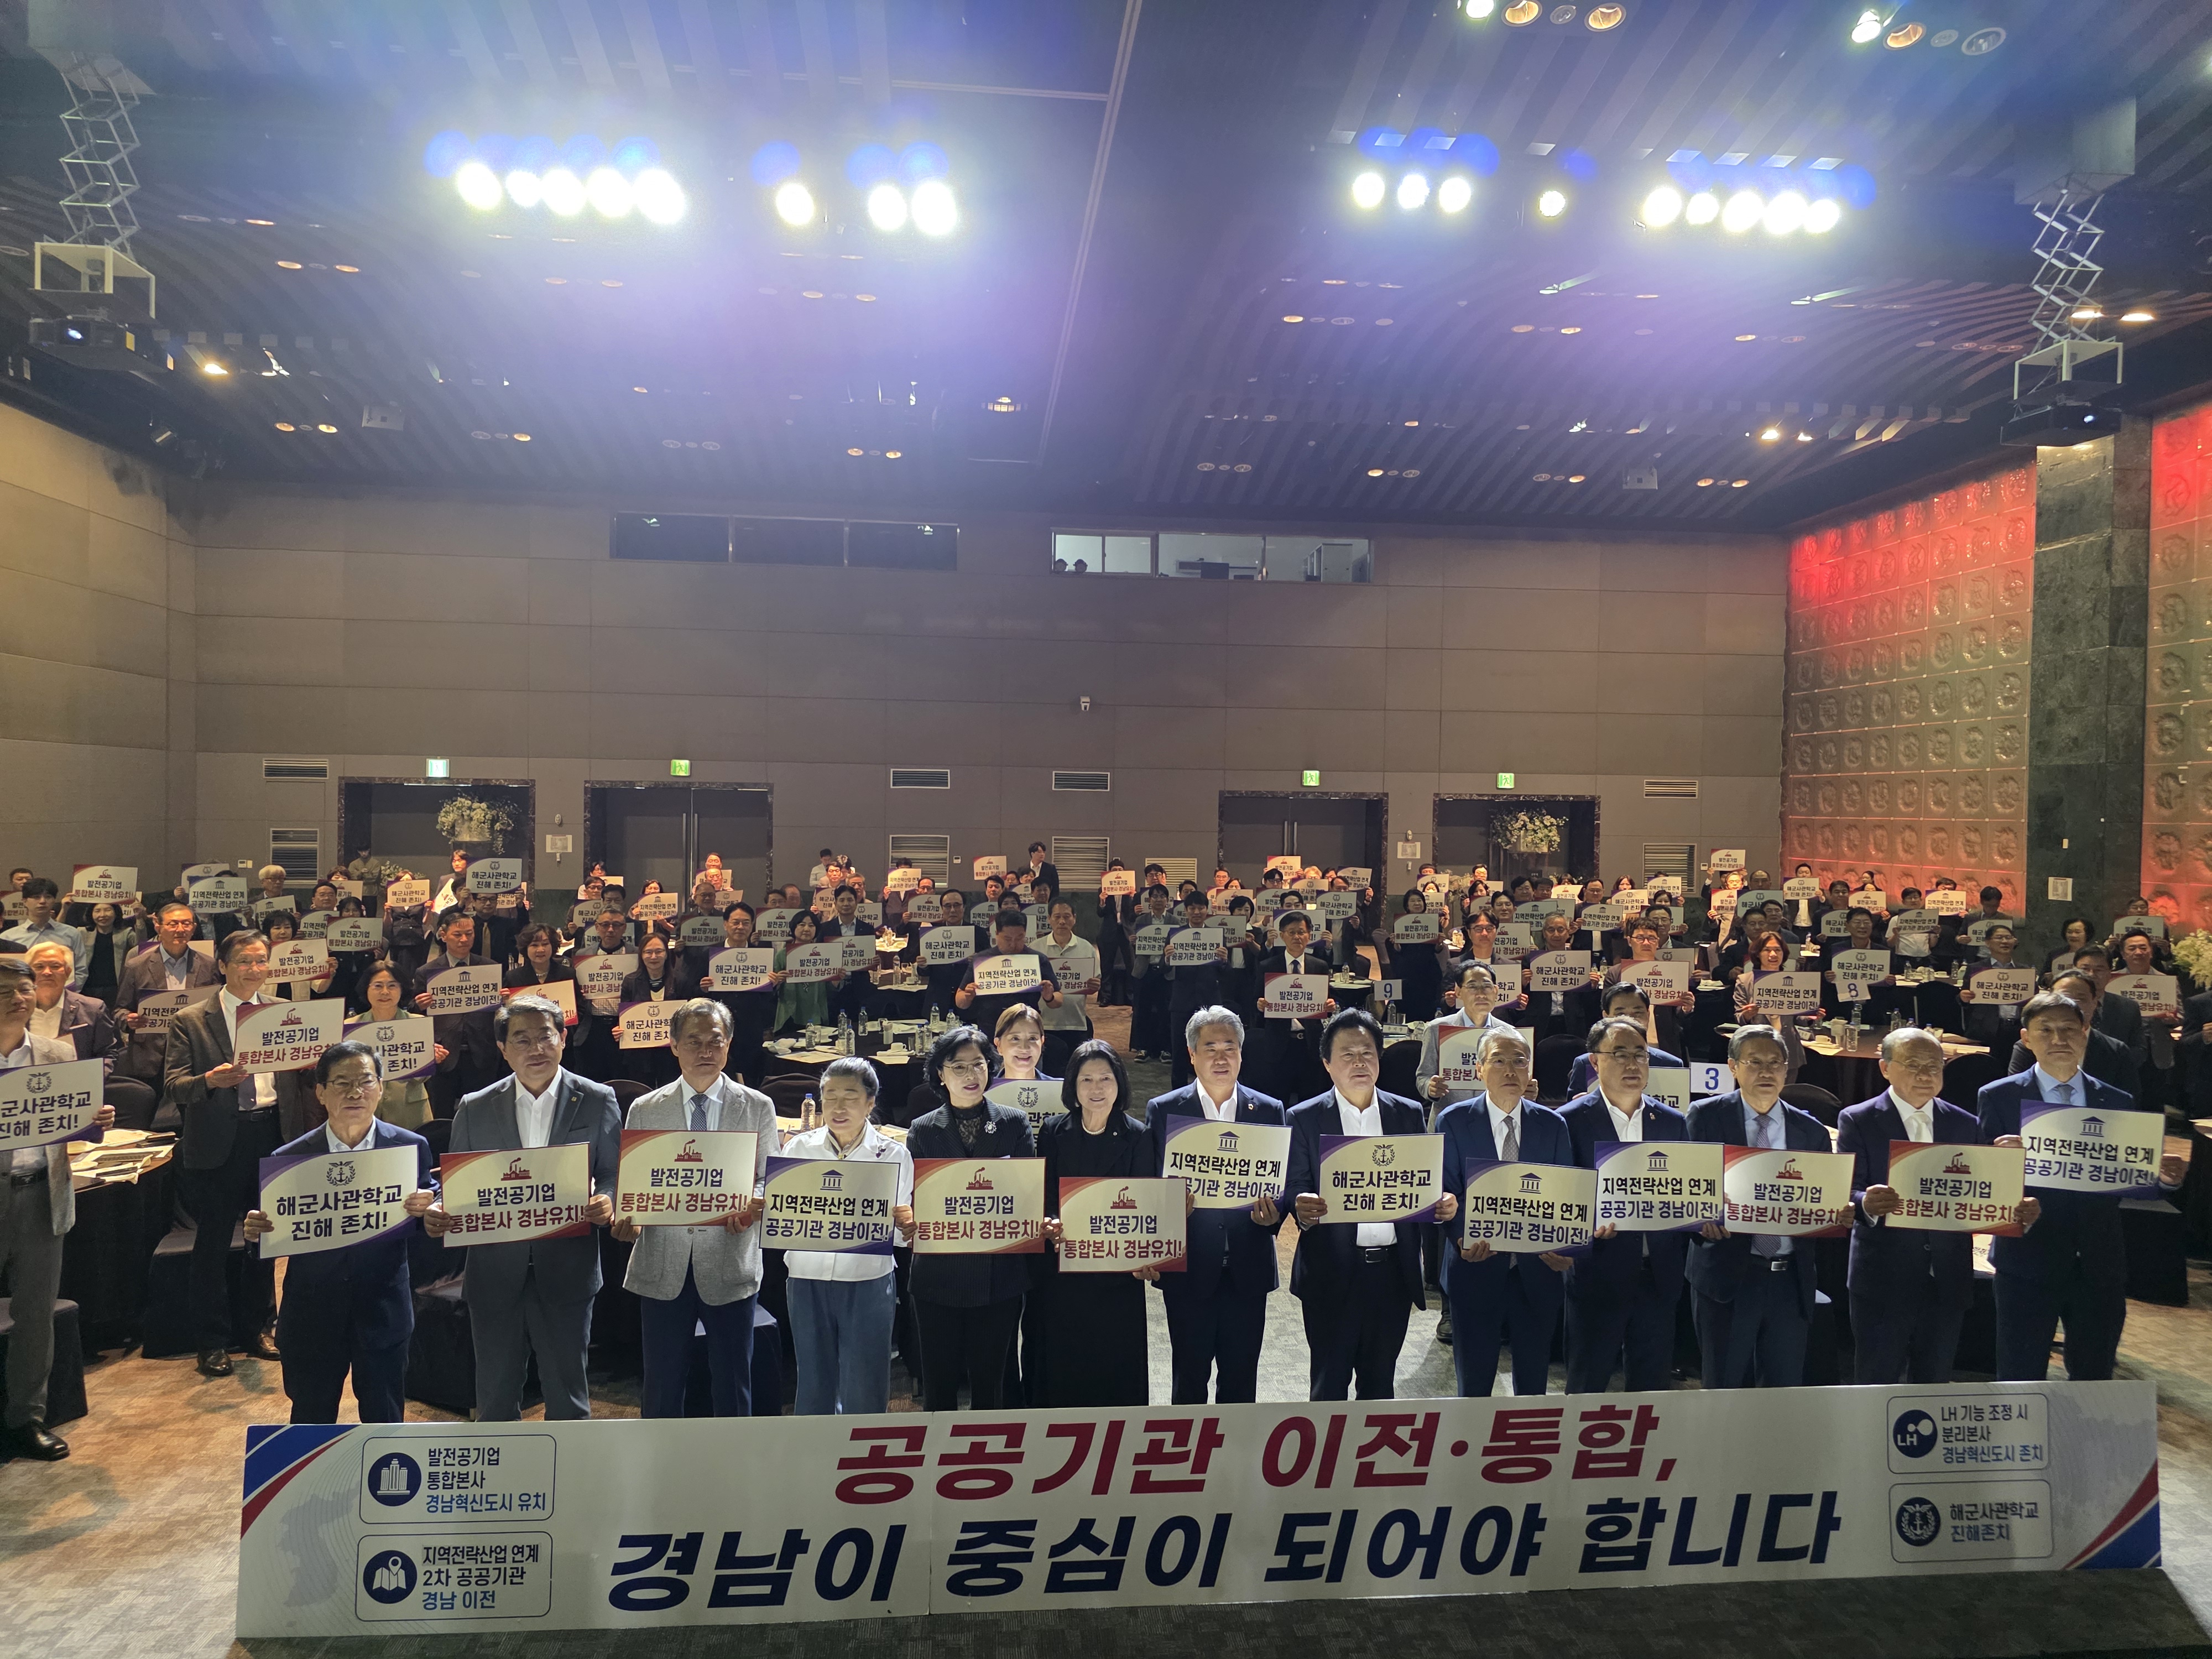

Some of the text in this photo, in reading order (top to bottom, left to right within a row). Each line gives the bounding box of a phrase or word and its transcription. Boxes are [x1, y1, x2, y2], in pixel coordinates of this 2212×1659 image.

[87, 880, 122, 889] 발전공기업
[75, 890, 102, 899] 통합본사
[1320, 901, 1353, 909] 해군사관학교
[340, 930, 370, 938] 발전공기업
[925, 941, 969, 950] 해군사관학교
[947, 950, 964, 958] 존치!
[1173, 942, 1207, 951] 지역전략산업
[1504, 946, 1528, 954] 경남유치!
[279, 956, 314, 966] 발전공기업
[800, 958, 830, 967] 발전공기업
[1172, 952, 1194, 961] 공공기관
[268, 965, 329, 978] 통합본사 경남유치!
[716, 964, 767, 974] 해군사관학교
[789, 969, 813, 978] 통합본사
[978, 969, 1020, 979] 지역전략산업
[1536, 967, 1584, 975] 해군사관학교
[1837, 962, 1884, 971] 해군사관학교
[588, 972, 624, 982] 발전공기업
[721, 976, 761, 985] 진해 존치!
[978, 978, 1039, 989] 공공기관 경남이전!
[1542, 977, 1558, 986] 진해
[1636, 977, 1673, 988] 발전공기업
[1976, 981, 2028, 990] 해군사관학교
[431, 983, 498, 997] 지역전략산업 연계
[1280, 991, 1313, 1001] 발전공기업
[1384, 983, 1392, 998] 9
[1757, 988, 1817, 999] 지역전략산업 연계
[1848, 983, 1859, 998] 8
[1981, 992, 2022, 1000] 진해 존치!
[430, 995, 500, 1009] 공공기관 경남이전!
[1266, 1003, 1326, 1013] 통합본사 경남유치!
[1756, 1000, 1819, 1010] 공공기관 경남이전!
[262, 1027, 319, 1046] 발전공기업
[633, 1032, 651, 1042] 진해
[238, 1048, 286, 1065] 통합본사
[388, 1058, 417, 1072] 존치!
[1705, 1067, 1719, 1090] 3
[1, 1091, 91, 1118] 군사관학교
[38, 1114, 78, 1134] 존치!
[2027, 1135, 2154, 1165] 지역전략산업 연계
[1170, 1152, 1281, 1178] 지역전략산업 연계
[2025, 1158, 2154, 1187] 공공기관 경남이전!
[650, 1168, 723, 1187] 발전공기업
[1332, 1170, 1431, 1189] 해군사관학교
[477, 1183, 555, 1207] 발전공기업
[1224, 1182, 1280, 1200] 경남이전!
[1603, 1178, 1715, 1196] 지역전략산업 연계
[1754, 1182, 1823, 1204] 발전공기업
[1919, 1177, 1992, 1199] 발전공기업
[276, 1184, 403, 1217] 해군사관학교
[621, 1193, 748, 1213] 통합본사 경남유치!
[770, 1194, 889, 1217] 지역전략산업 연계
[945, 1196, 1014, 1215] 발전공기업
[1343, 1193, 1419, 1211] 진해 존치!
[1472, 1196, 1588, 1222] 지역전략산업 연계
[1897, 1199, 1949, 1220] 통합본사
[449, 1205, 585, 1234] 통합본사 경남유치!
[1600, 1201, 1719, 1220] 공공기관 경남이전!
[1727, 1203, 1783, 1223] 통합본사
[291, 1212, 388, 1241] 진해 존치!
[765, 1218, 889, 1241] 공공기관 경남이전!
[918, 1219, 1040, 1240] 통합본사 경남유치!
[1089, 1215, 1157, 1234] 발전공기업
[1468, 1220, 1589, 1245] 공공기관 경남이전!
[1064, 1239, 1182, 1259] 통합본사 경남유치!
[1941, 1406, 1957, 1421] LH
[2016, 1404, 2028, 1421] 시
[1897, 1434, 1917, 1446] LH
[1942, 1425, 1991, 1443] 분리본사
[428, 1447, 500, 1467] 발전공기업
[833, 1404, 1677, 1505] 공공기관 이전·통합,
[1943, 1444, 2043, 1464] 경남혁신도시 존치
[427, 1470, 486, 1491] 통합본사
[426, 1491, 546, 1514] 경남혁신도시 유치
[1950, 1503, 2038, 1520] 해군사관학교
[1950, 1524, 2010, 1542] 진해존치
[423, 1545, 539, 1565] 지역전략산업 연계
[608, 1491, 1843, 1611] 경남이 중심이 되어야 합니다
[423, 1567, 526, 1587] 2차 공공기관
[422, 1589, 496, 1611] 경남 이전
